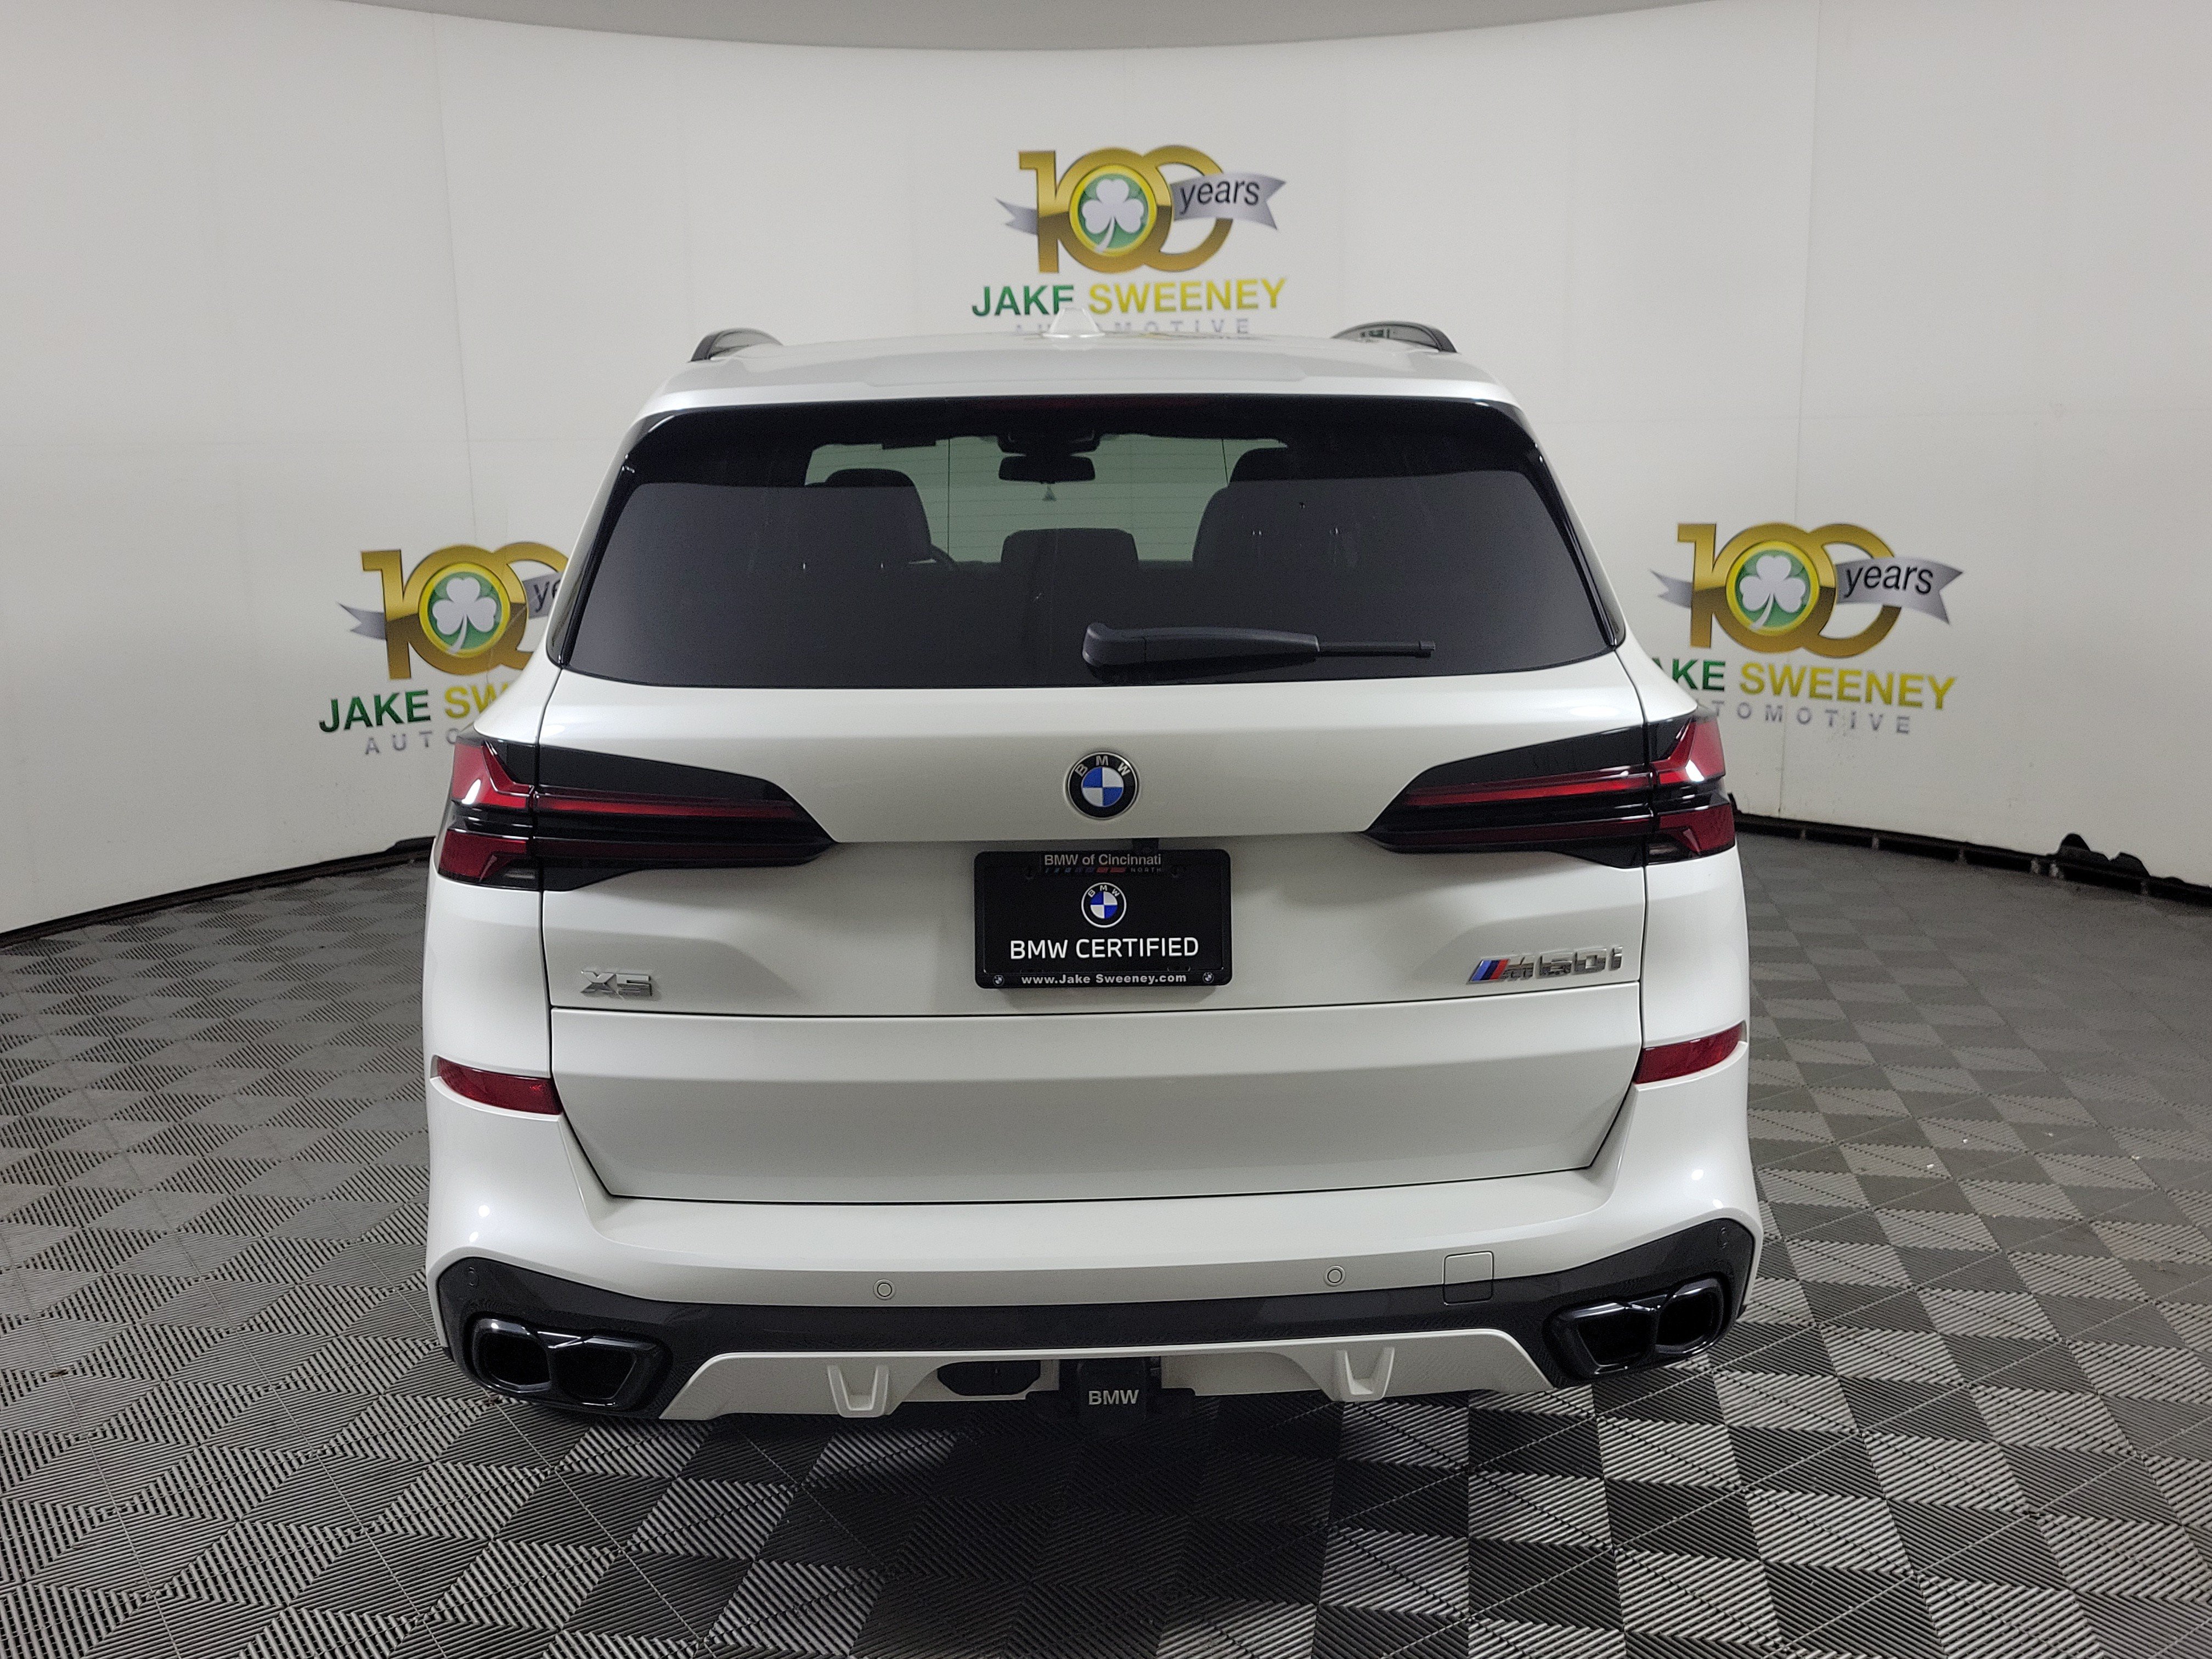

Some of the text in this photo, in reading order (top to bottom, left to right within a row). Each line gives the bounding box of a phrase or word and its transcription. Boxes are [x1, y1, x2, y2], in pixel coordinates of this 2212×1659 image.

[1019, 144, 1234, 274] 100
[1179, 180, 1260, 213] years
[1088, 278, 1286, 315] SWEENEY
[1677, 522, 1902, 658] 100
[1843, 562, 1933, 598] years
[1740, 662, 1957, 711] SWEENEY
[318, 689, 431, 733] JAKE
[1074, 755, 1131, 777] BMW
[1044, 854, 1162, 865] BMW of Cincinnati
[1087, 884, 1120, 898] BMW
[1010, 936, 1199, 959] BMW CERTIFIED
[1021, 973, 1187, 985] www.Jake Sweeney.com
[1088, 1389, 1139, 1406] BMW
